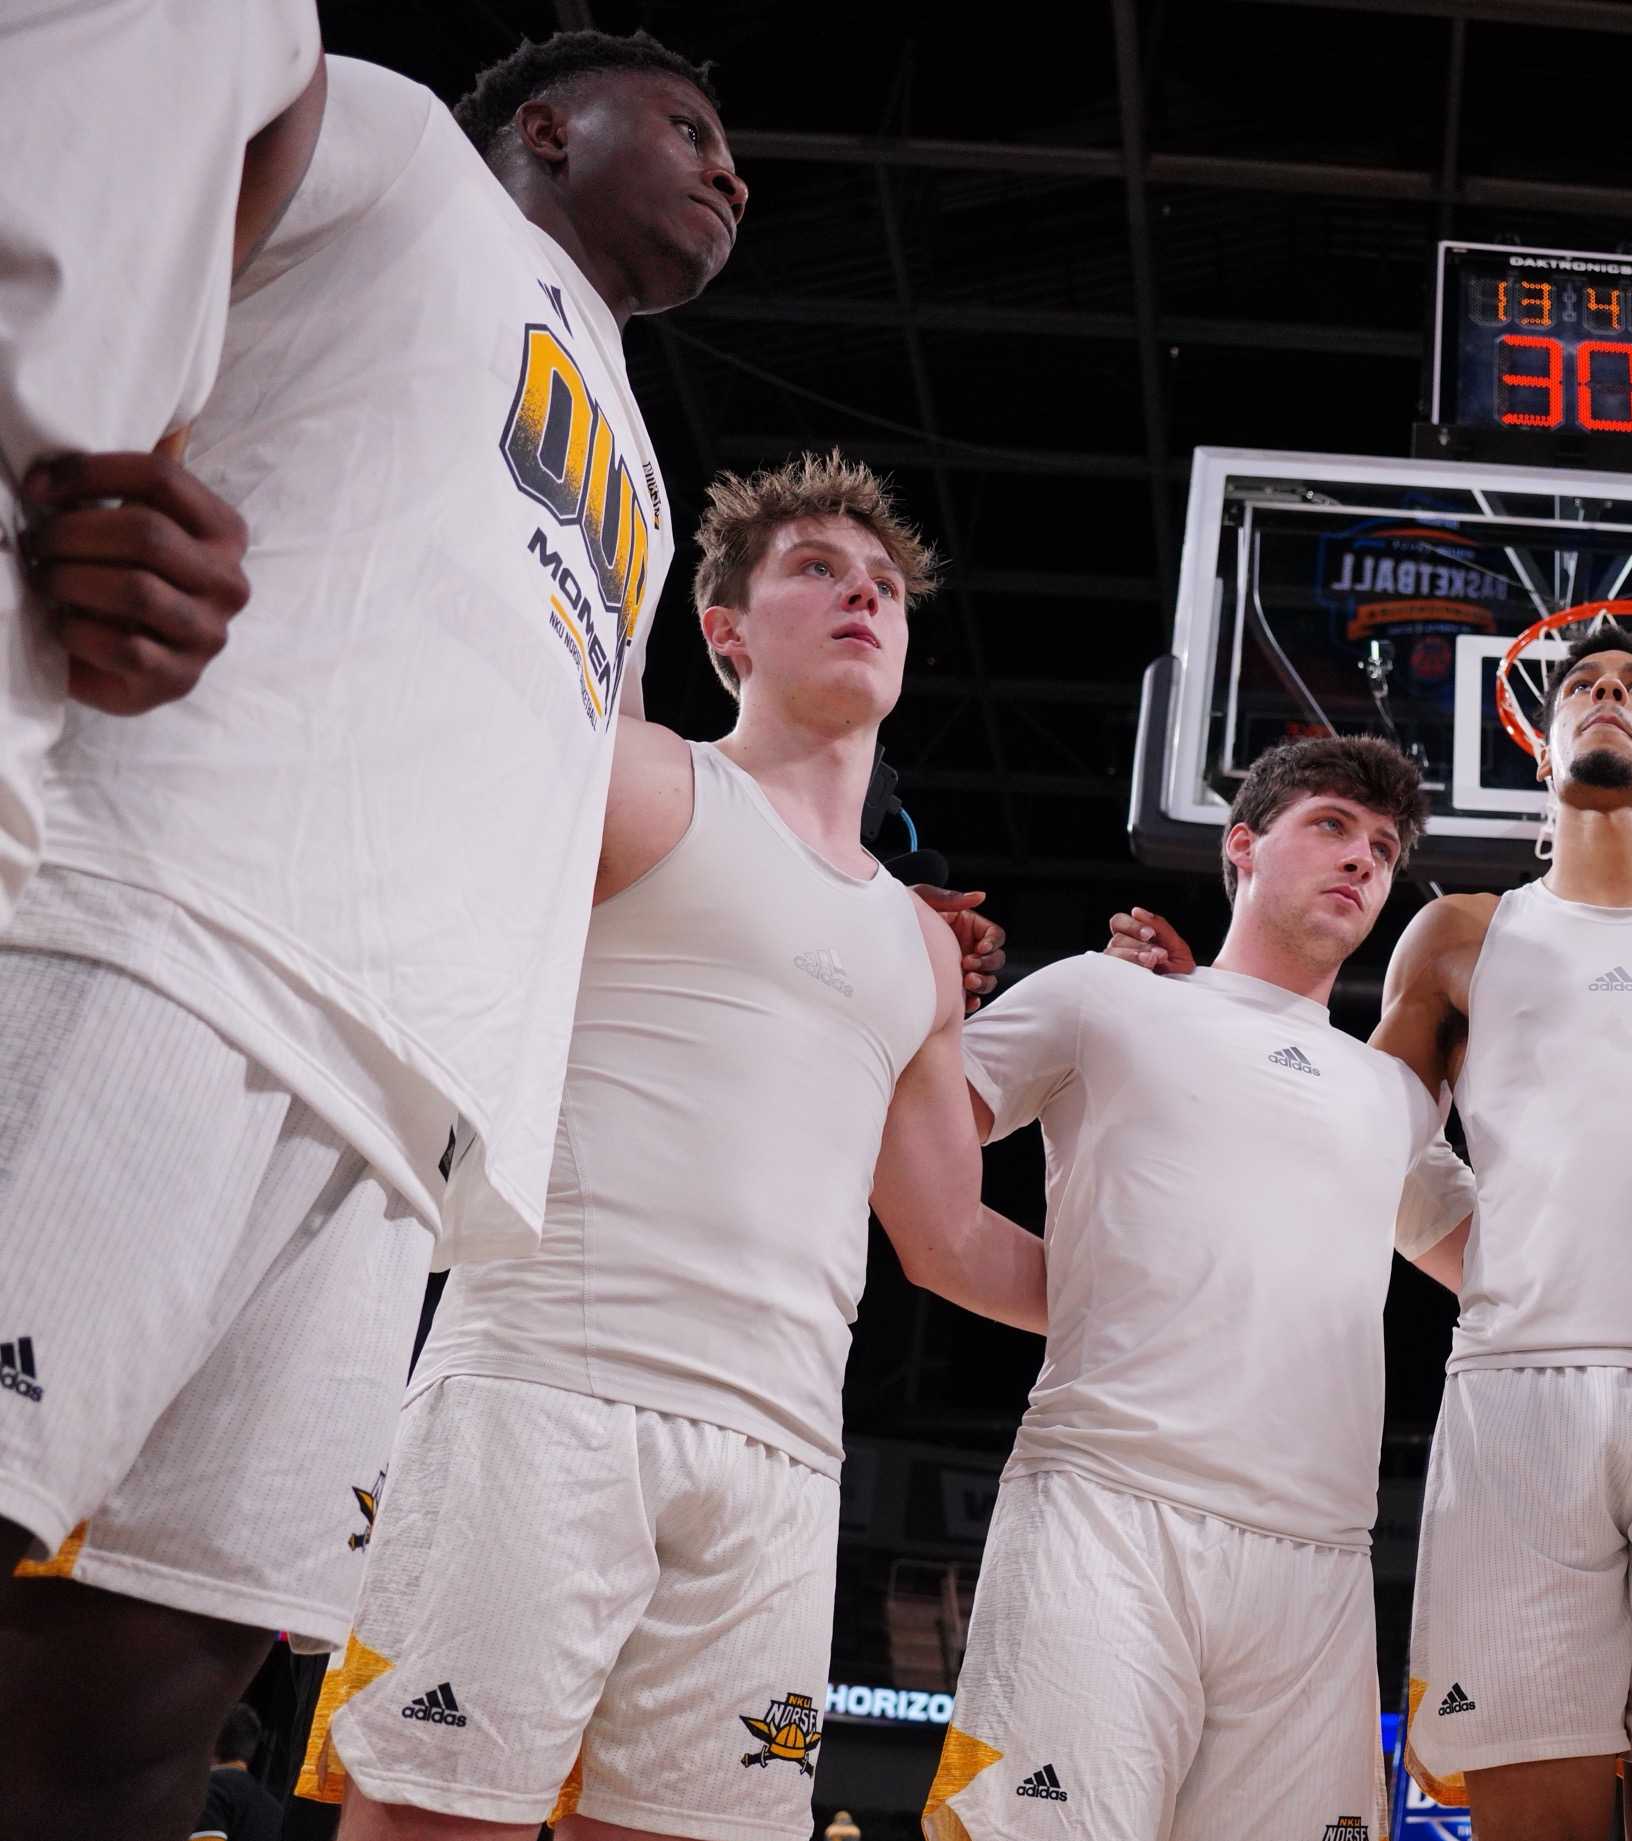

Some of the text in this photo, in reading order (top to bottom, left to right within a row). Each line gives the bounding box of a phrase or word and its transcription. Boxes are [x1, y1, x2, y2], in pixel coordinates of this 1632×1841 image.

[549, 611, 565, 640] NKU
[1268, 1054, 1321, 1077] adidas
[788, 1695, 812, 1708] NKU
[1438, 1700, 1477, 1716] adidas
[402, 1704, 467, 1728] adidas
[1016, 1782, 1068, 1803] adidas
[1339, 1818, 1361, 1826] NKU
